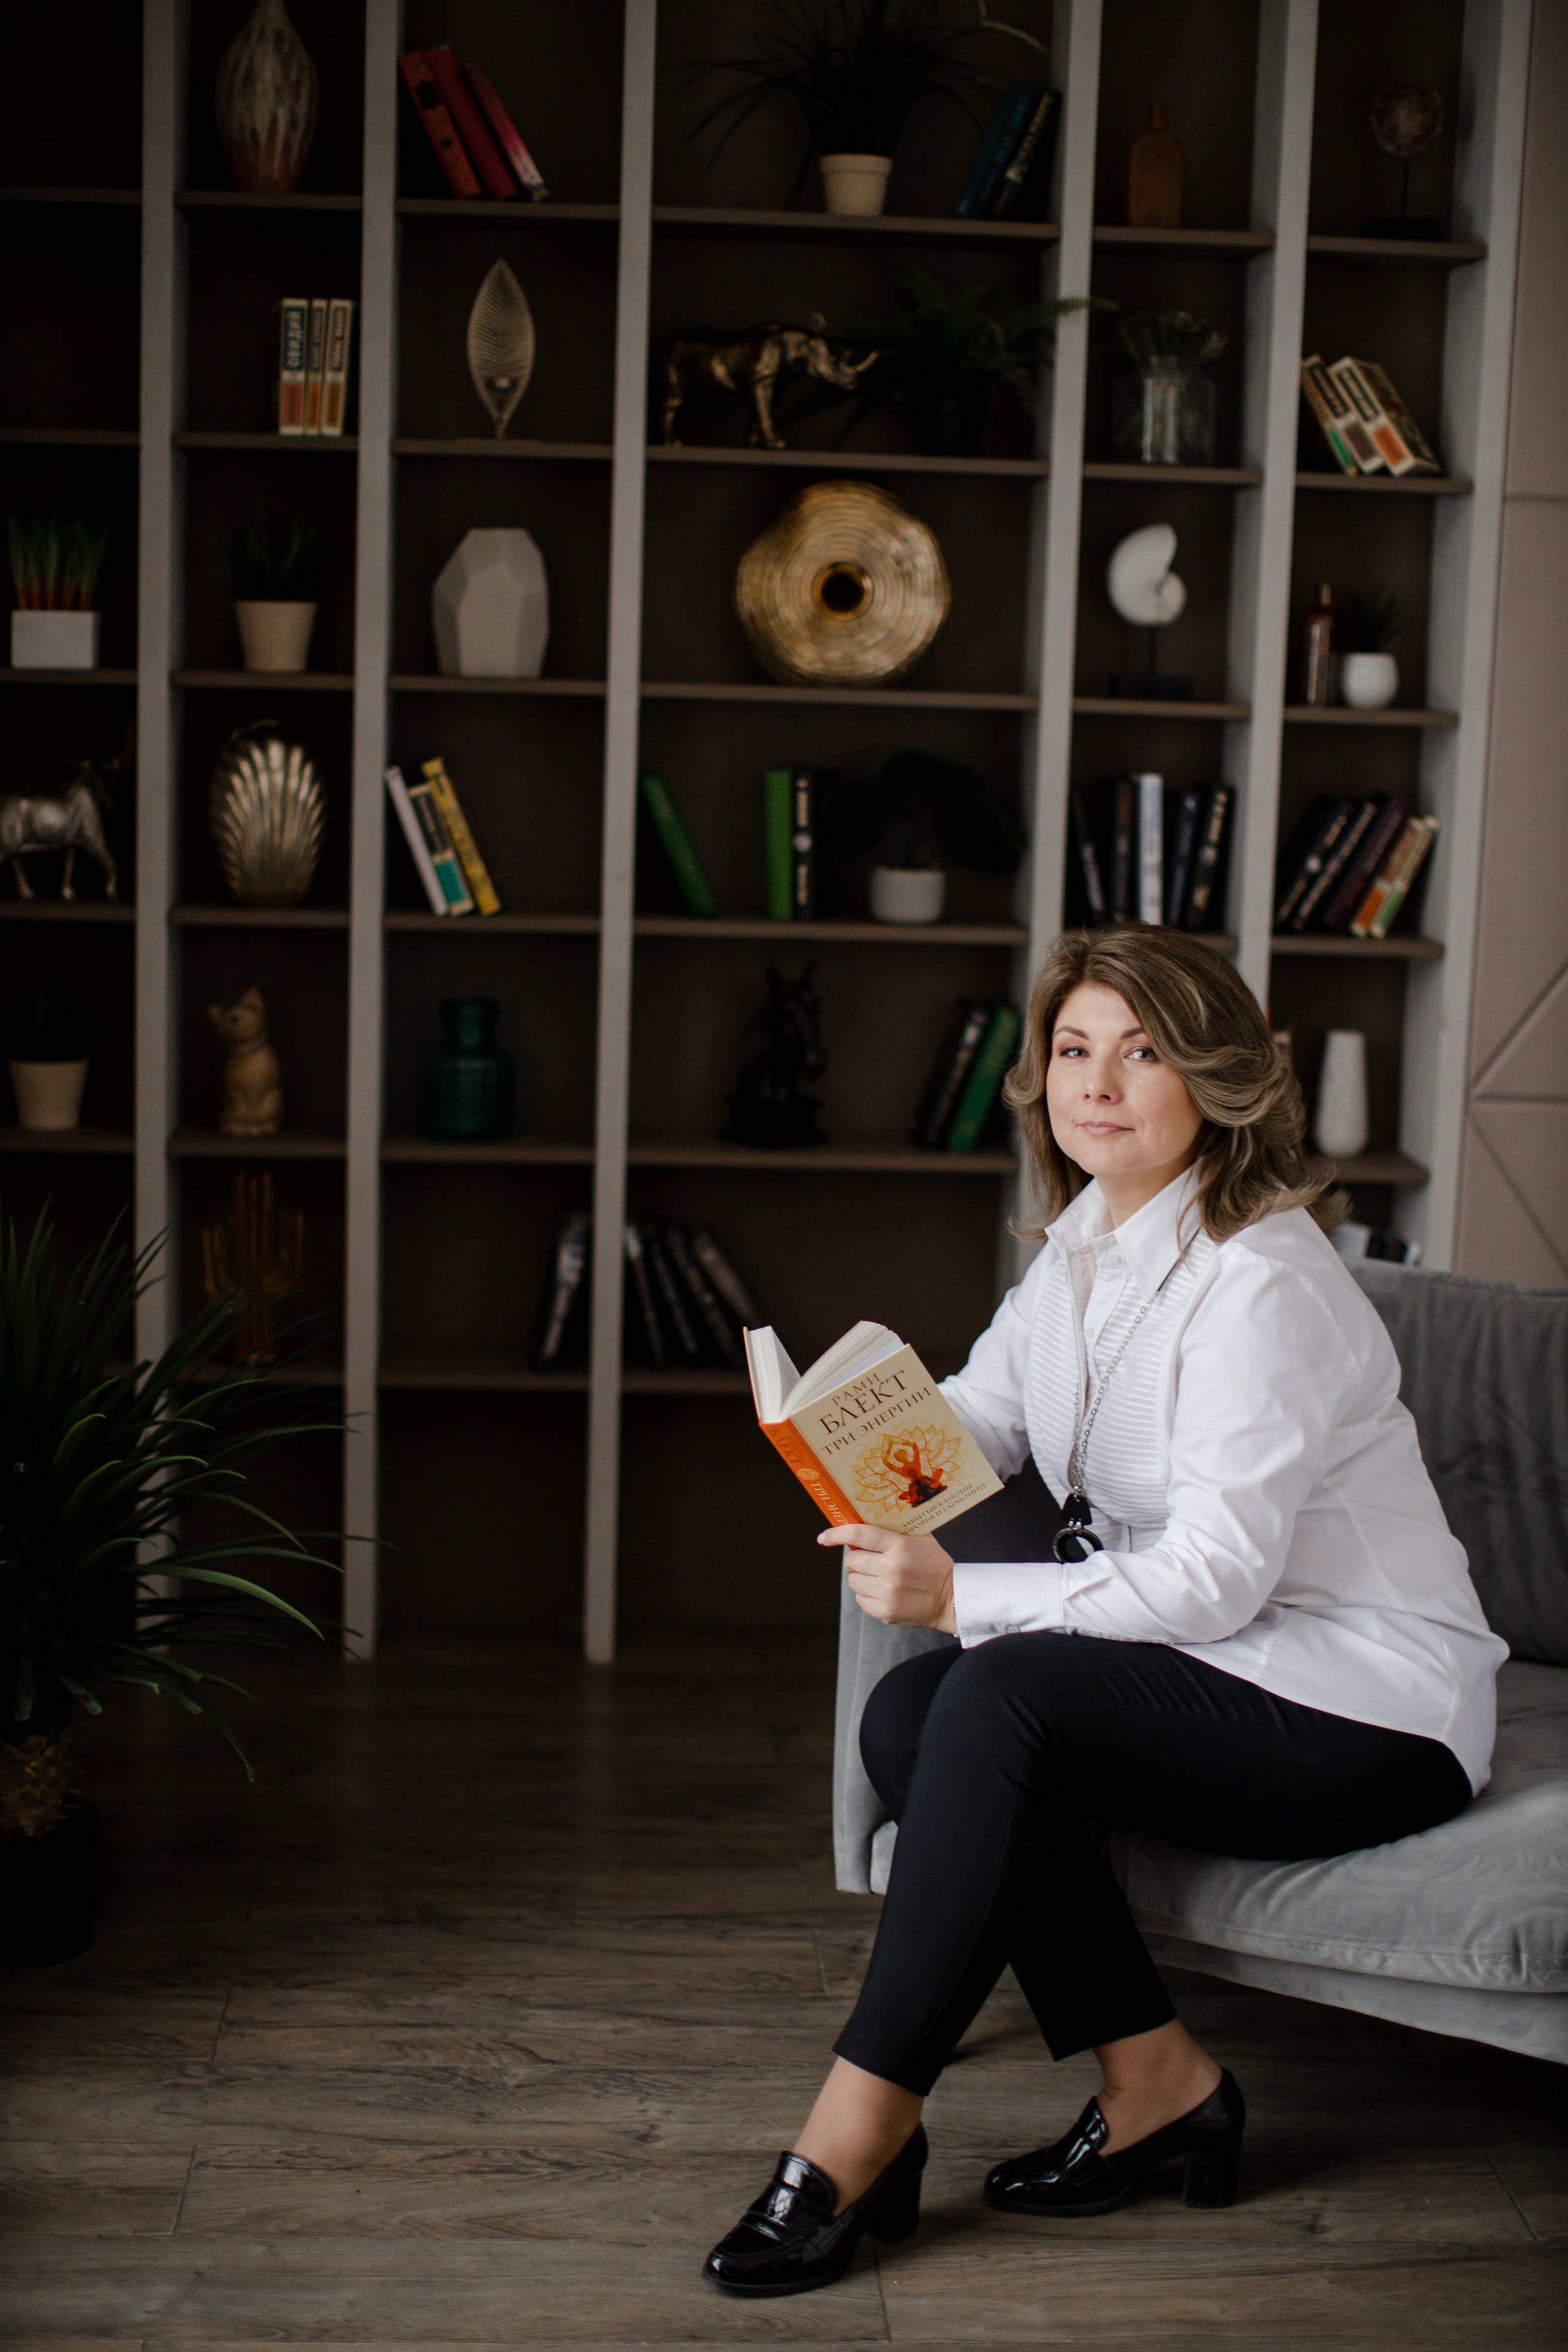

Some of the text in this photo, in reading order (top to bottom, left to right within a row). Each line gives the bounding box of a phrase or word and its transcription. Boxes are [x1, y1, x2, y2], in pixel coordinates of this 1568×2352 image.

[818, 1370, 908, 1435] БЛЕКТ
[832, 1373, 880, 1406] РАМИ
[821, 1387, 931, 1455] ТРИ ЭНЕРГИИ
[810, 1481, 849, 1525] ТРИ ЭНЕР
[901, 1513, 935, 1536] ОРОВЬЯ
[942, 1483, 987, 1512] ГАРМОНИИ
[938, 1483, 973, 1507] КАНОНЫ
